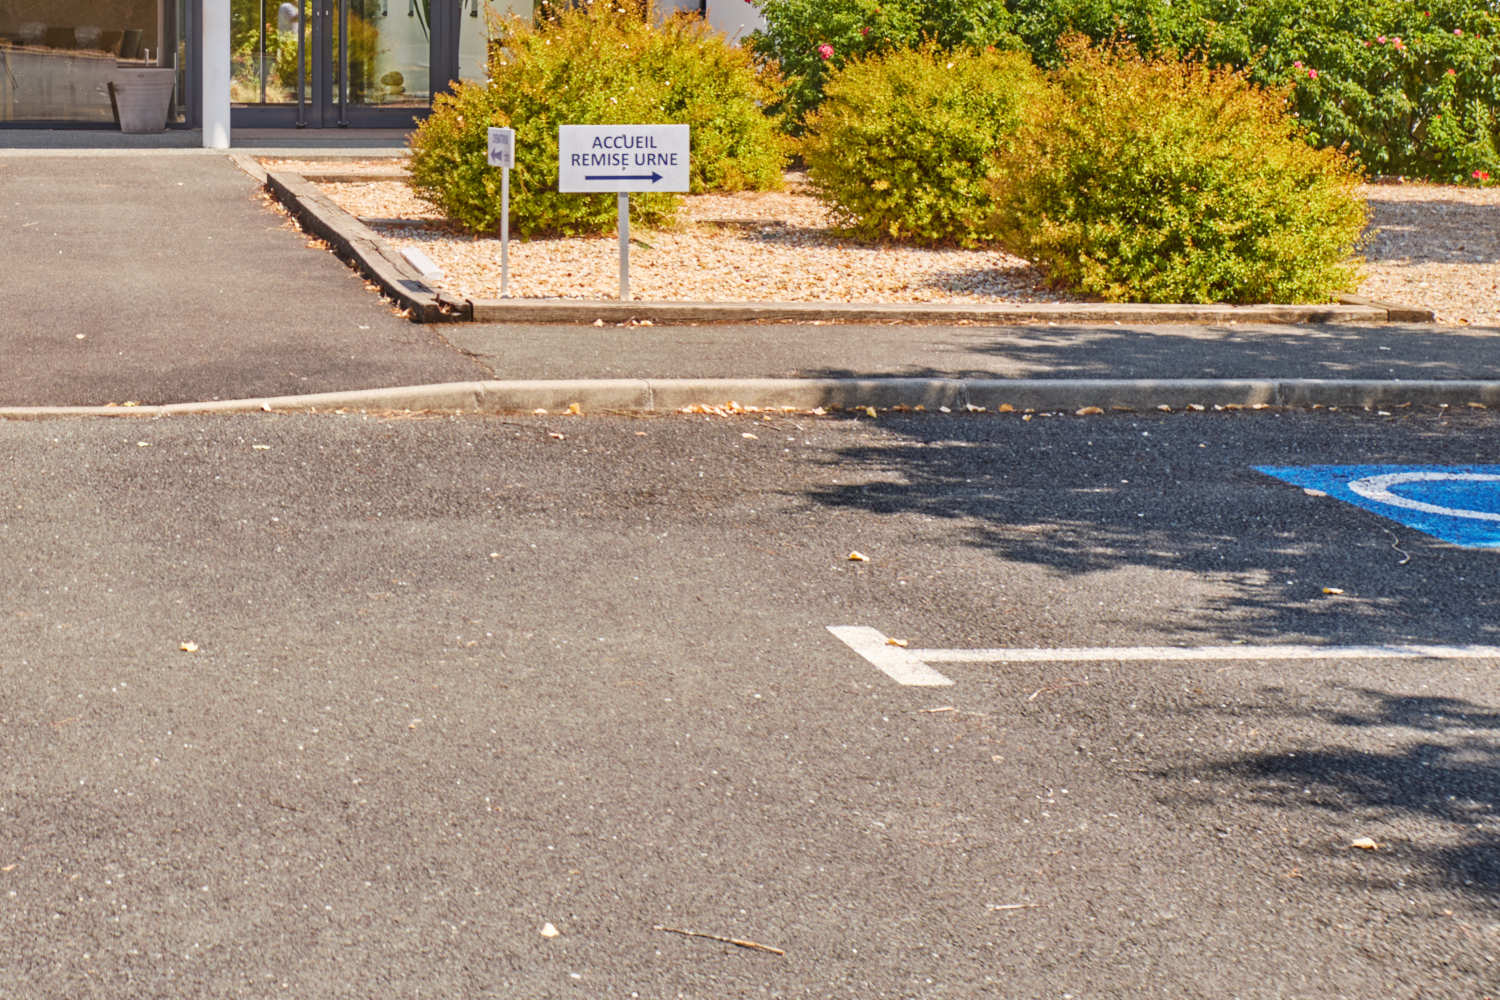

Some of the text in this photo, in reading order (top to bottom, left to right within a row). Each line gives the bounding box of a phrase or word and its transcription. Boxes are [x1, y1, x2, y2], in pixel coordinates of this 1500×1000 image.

[592, 136, 657, 149] ACCUEIL
[571, 153, 678, 166] REMISE URNE
